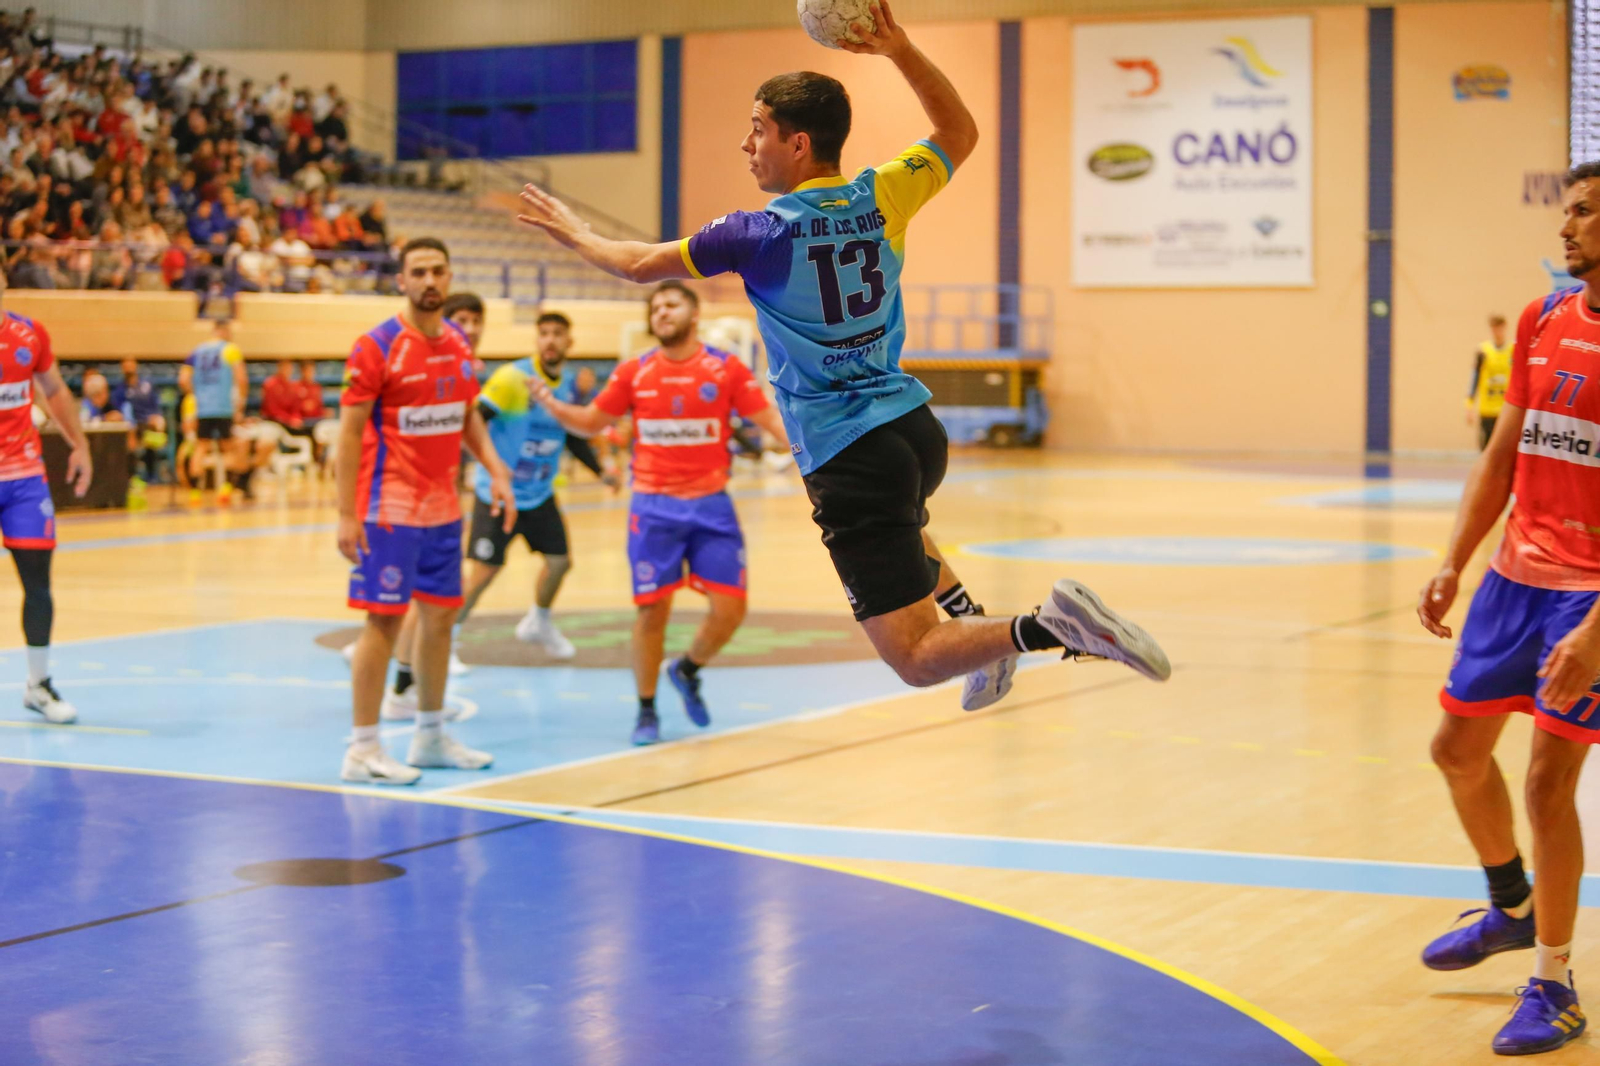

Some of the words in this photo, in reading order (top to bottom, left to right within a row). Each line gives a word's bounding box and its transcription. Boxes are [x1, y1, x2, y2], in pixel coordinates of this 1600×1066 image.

[1172, 121, 1299, 166] CANÓ
[811, 216, 830, 237] DE
[807, 239, 887, 326] 13
[1549, 370, 1587, 407] 77
